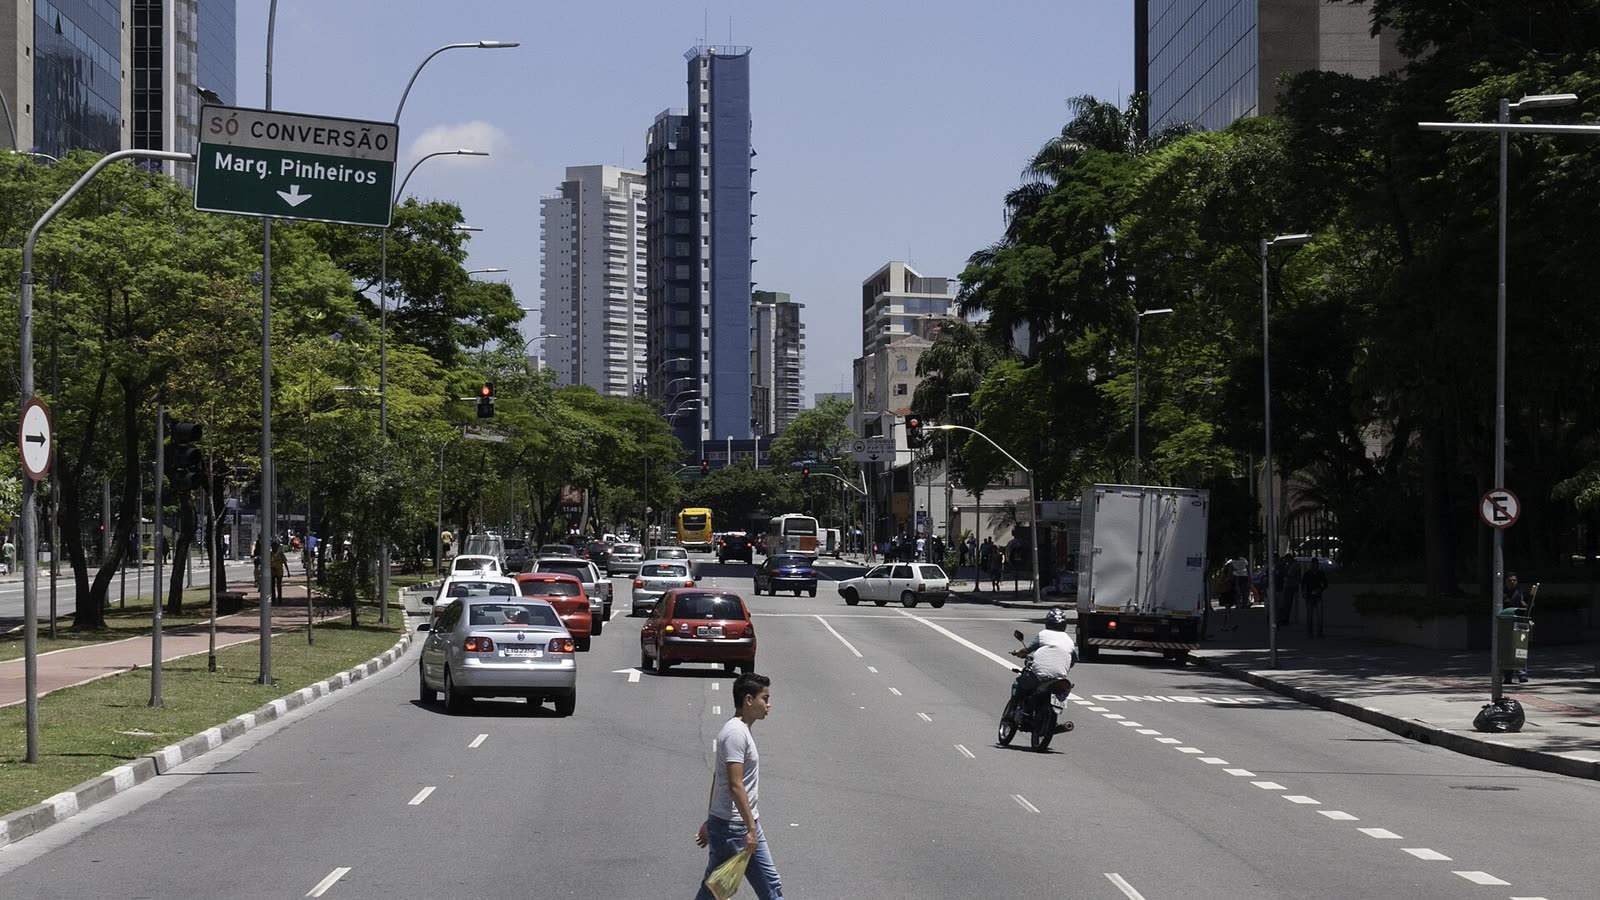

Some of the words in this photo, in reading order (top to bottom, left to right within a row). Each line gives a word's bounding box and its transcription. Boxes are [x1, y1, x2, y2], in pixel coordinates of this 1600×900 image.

[210, 113, 239, 136] SÓ
[251, 120, 388, 151] CONVERSÃO
[215, 151, 272, 179] Marg.
[280, 158, 377, 185] Pinheiros
